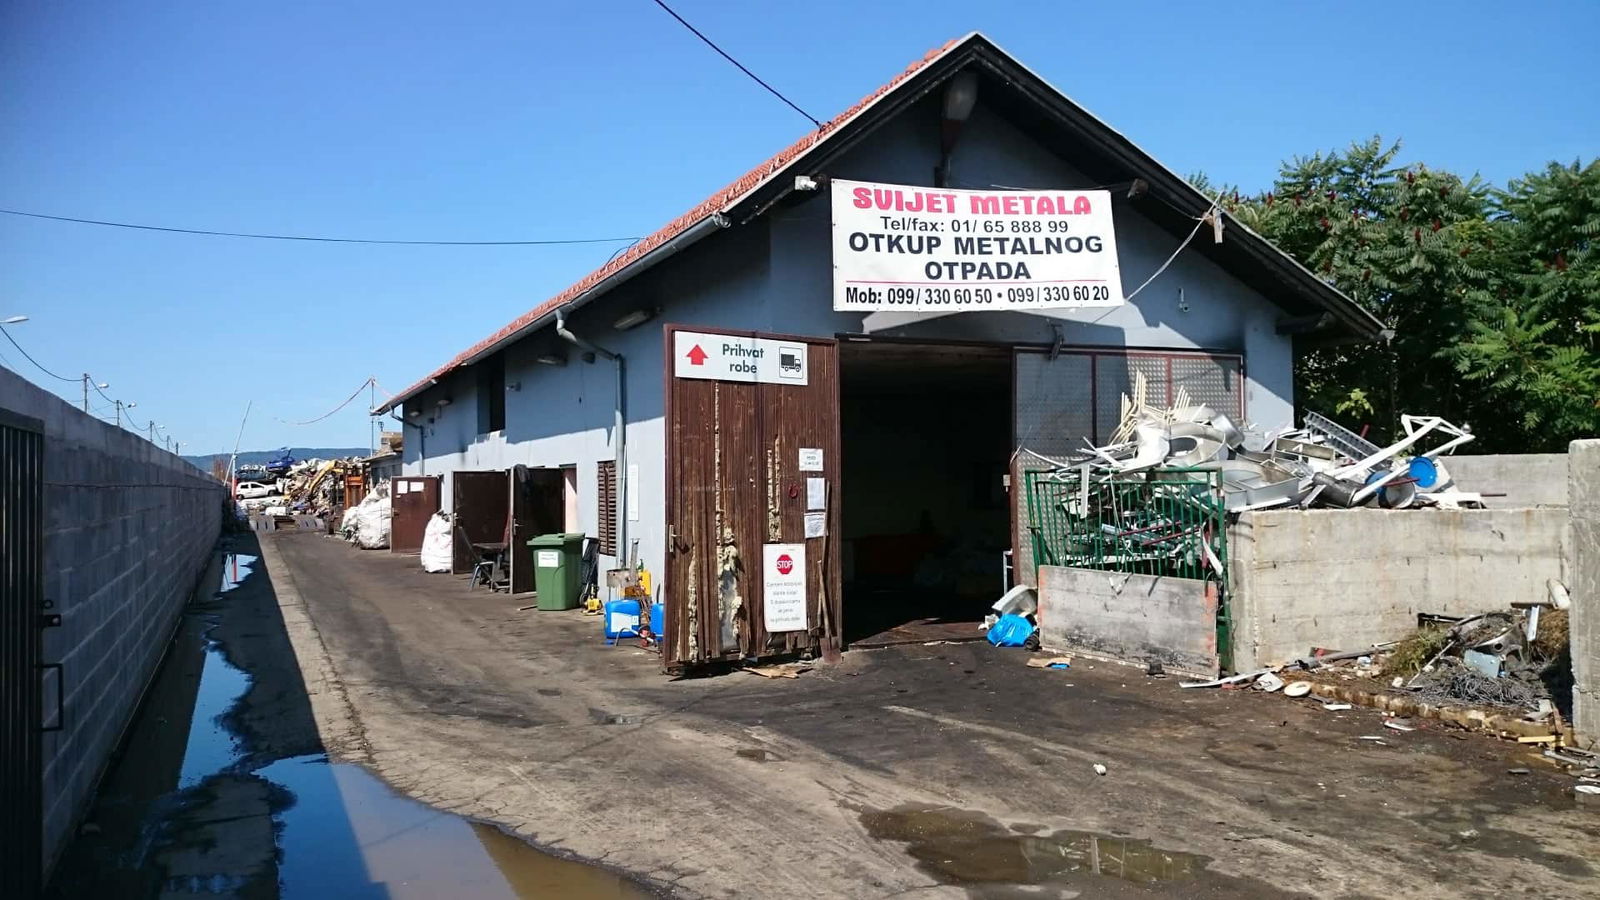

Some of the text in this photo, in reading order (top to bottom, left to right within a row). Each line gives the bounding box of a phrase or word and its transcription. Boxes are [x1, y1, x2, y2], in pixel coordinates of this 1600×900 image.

[853, 187, 1092, 215] SVIJET METALA
[880, 216, 944, 232] Tel/fax:
[983, 220, 1005, 233] 65
[1011, 220, 1042, 233] 888
[1048, 220, 1068, 233] 99
[849, 232, 1103, 255] OTKUP METALNOG
[925, 261, 1032, 280] OTPADA
[846, 287, 882, 304] Mob:
[924, 288, 951, 304] 330
[954, 288, 972, 304] 60
[975, 288, 993, 304] 50
[1043, 286, 1070, 302] 330
[1073, 285, 1090, 301] 60
[1092, 285, 1110, 301] 20
[722, 343, 765, 358] Prihvat
[730, 359, 758, 374] robe
[776, 560, 793, 569] STOP
